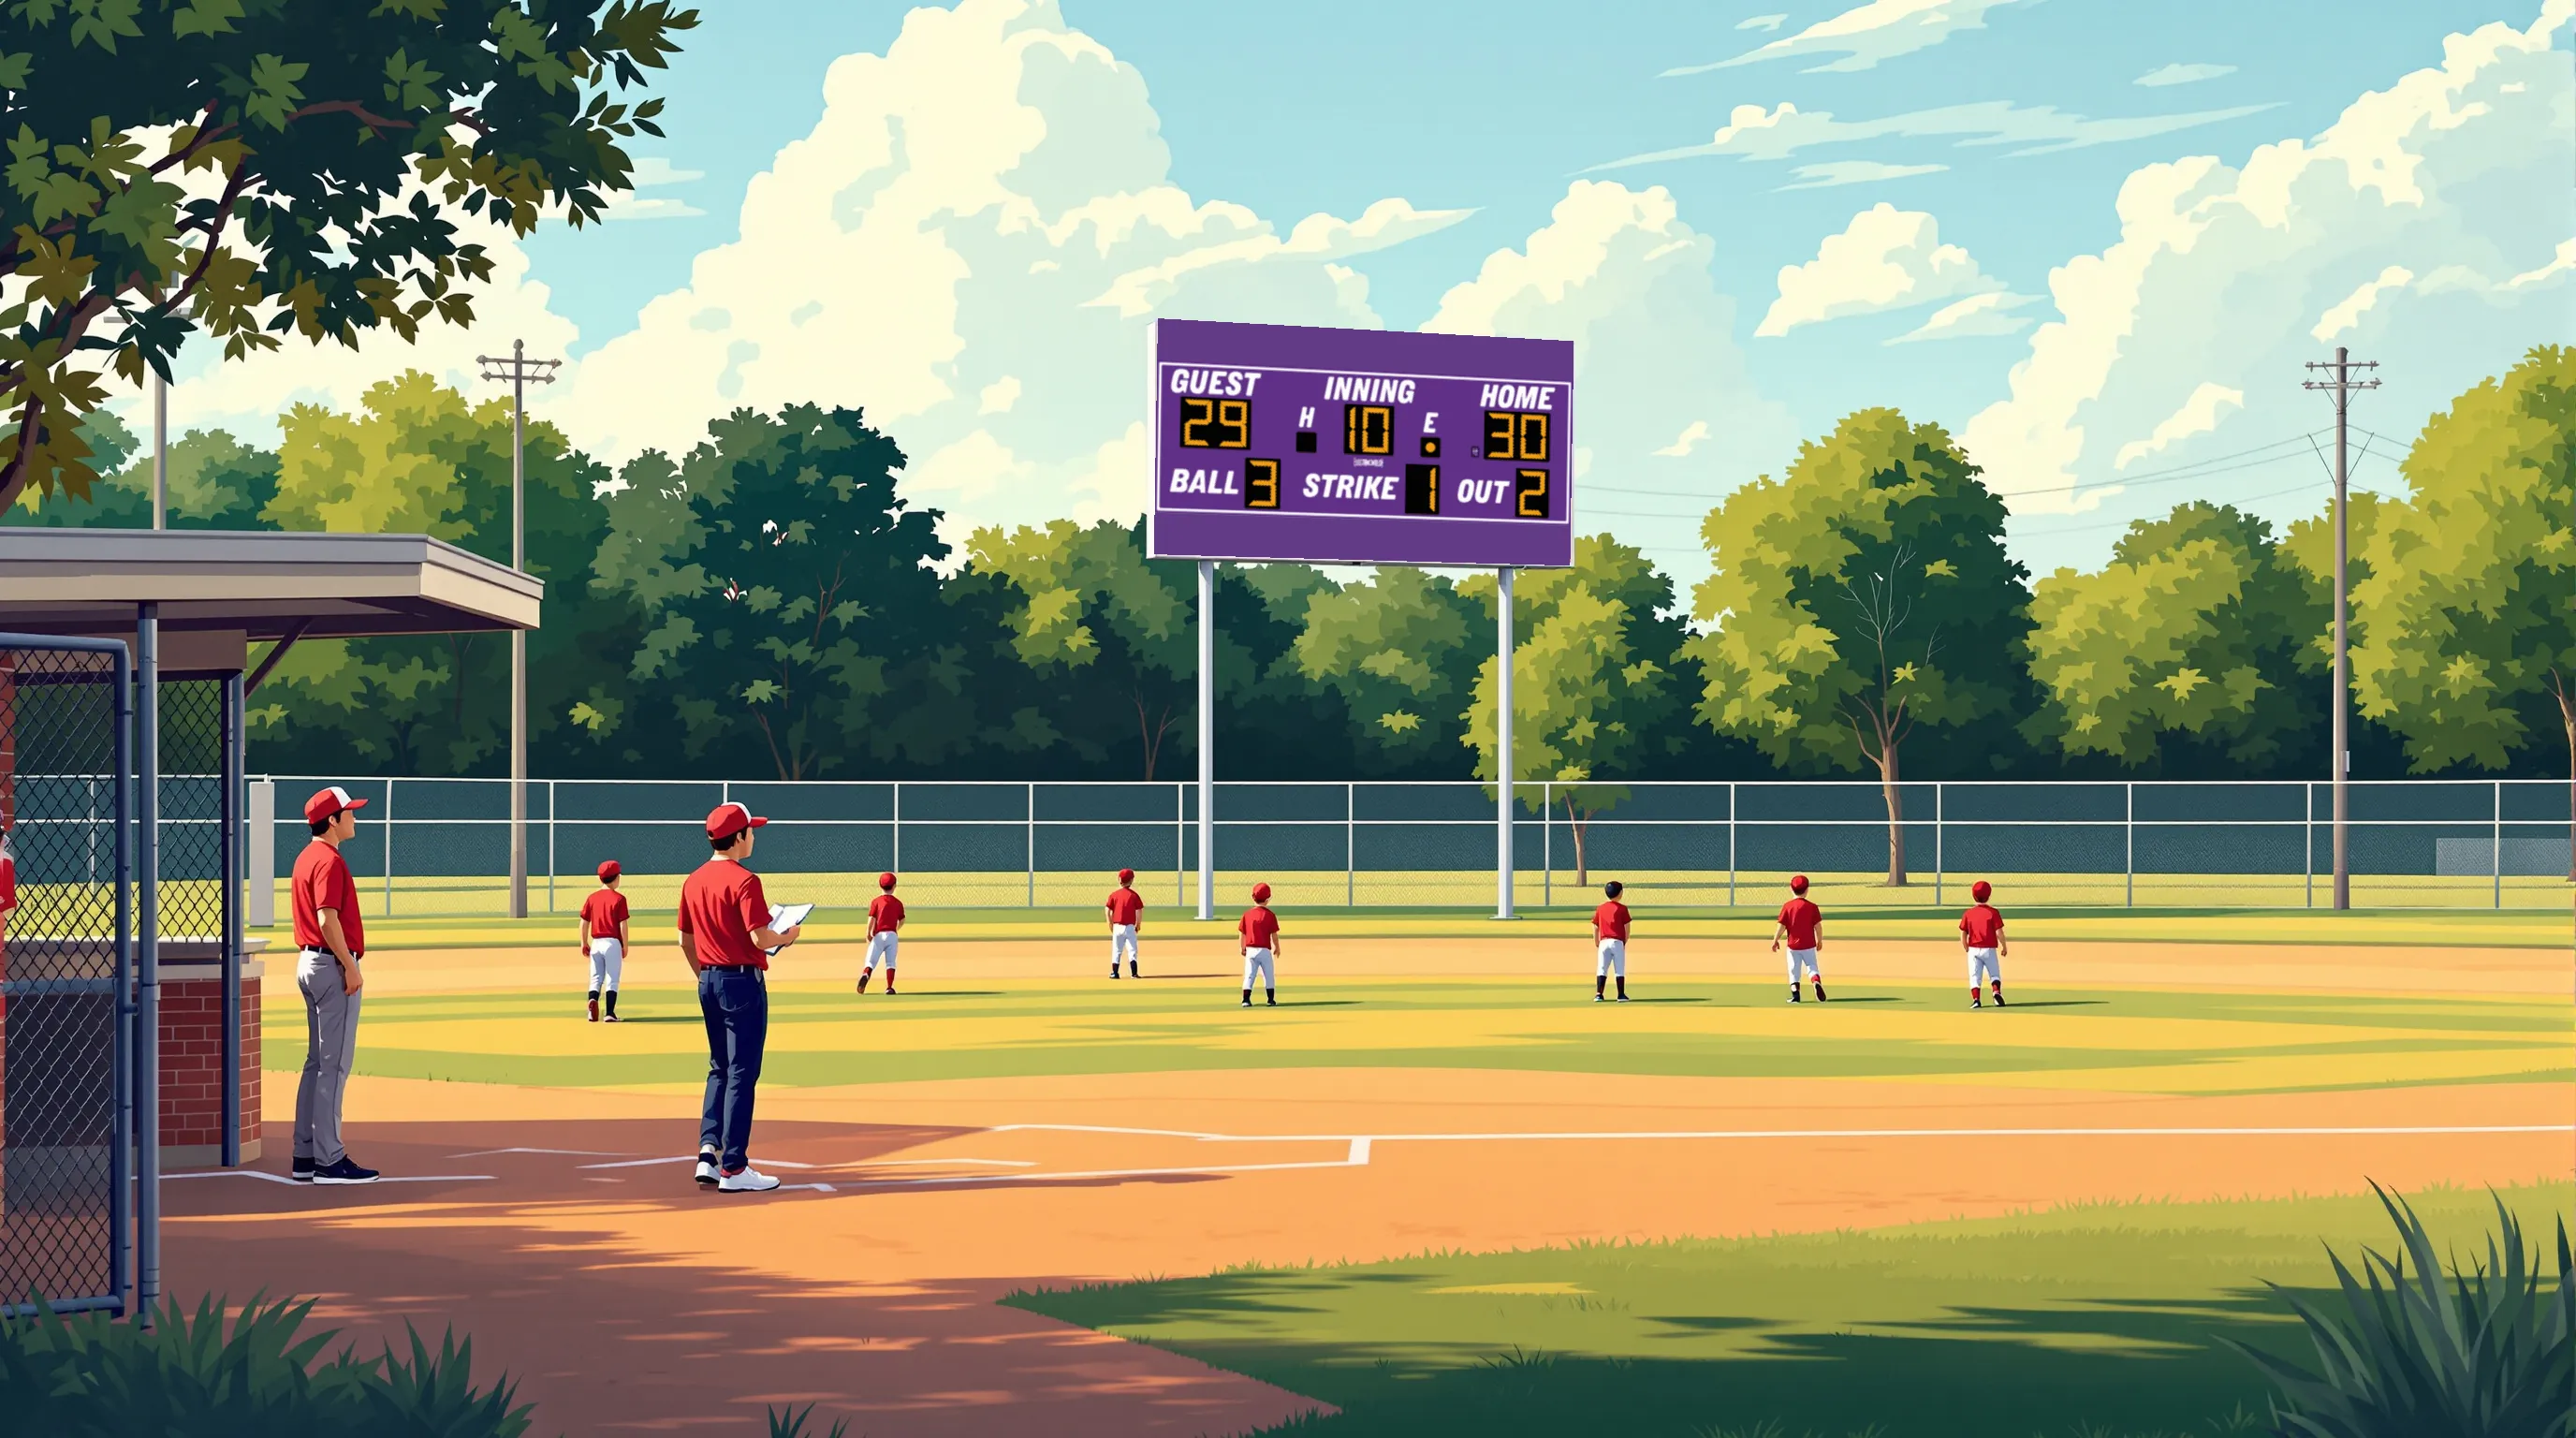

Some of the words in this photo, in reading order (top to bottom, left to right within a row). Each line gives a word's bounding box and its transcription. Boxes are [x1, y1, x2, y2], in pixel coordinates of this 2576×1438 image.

[1170, 368, 1262, 397] GUEST
[1324, 375, 1416, 404] INNING
[1479, 384, 1556, 410] HOME
[1183, 398, 1248, 448] 29
[1298, 405, 1316, 429] H
[1348, 405, 1390, 454] 10
[1423, 411, 1439, 433] E
[1487, 412, 1547, 460] 30
[1169, 468, 1239, 495] BALL
[1248, 459, 1278, 507] 3
[1302, 473, 1400, 500] STRIKE
[1456, 478, 1511, 504] OUT
[1518, 470, 1546, 516] 2
